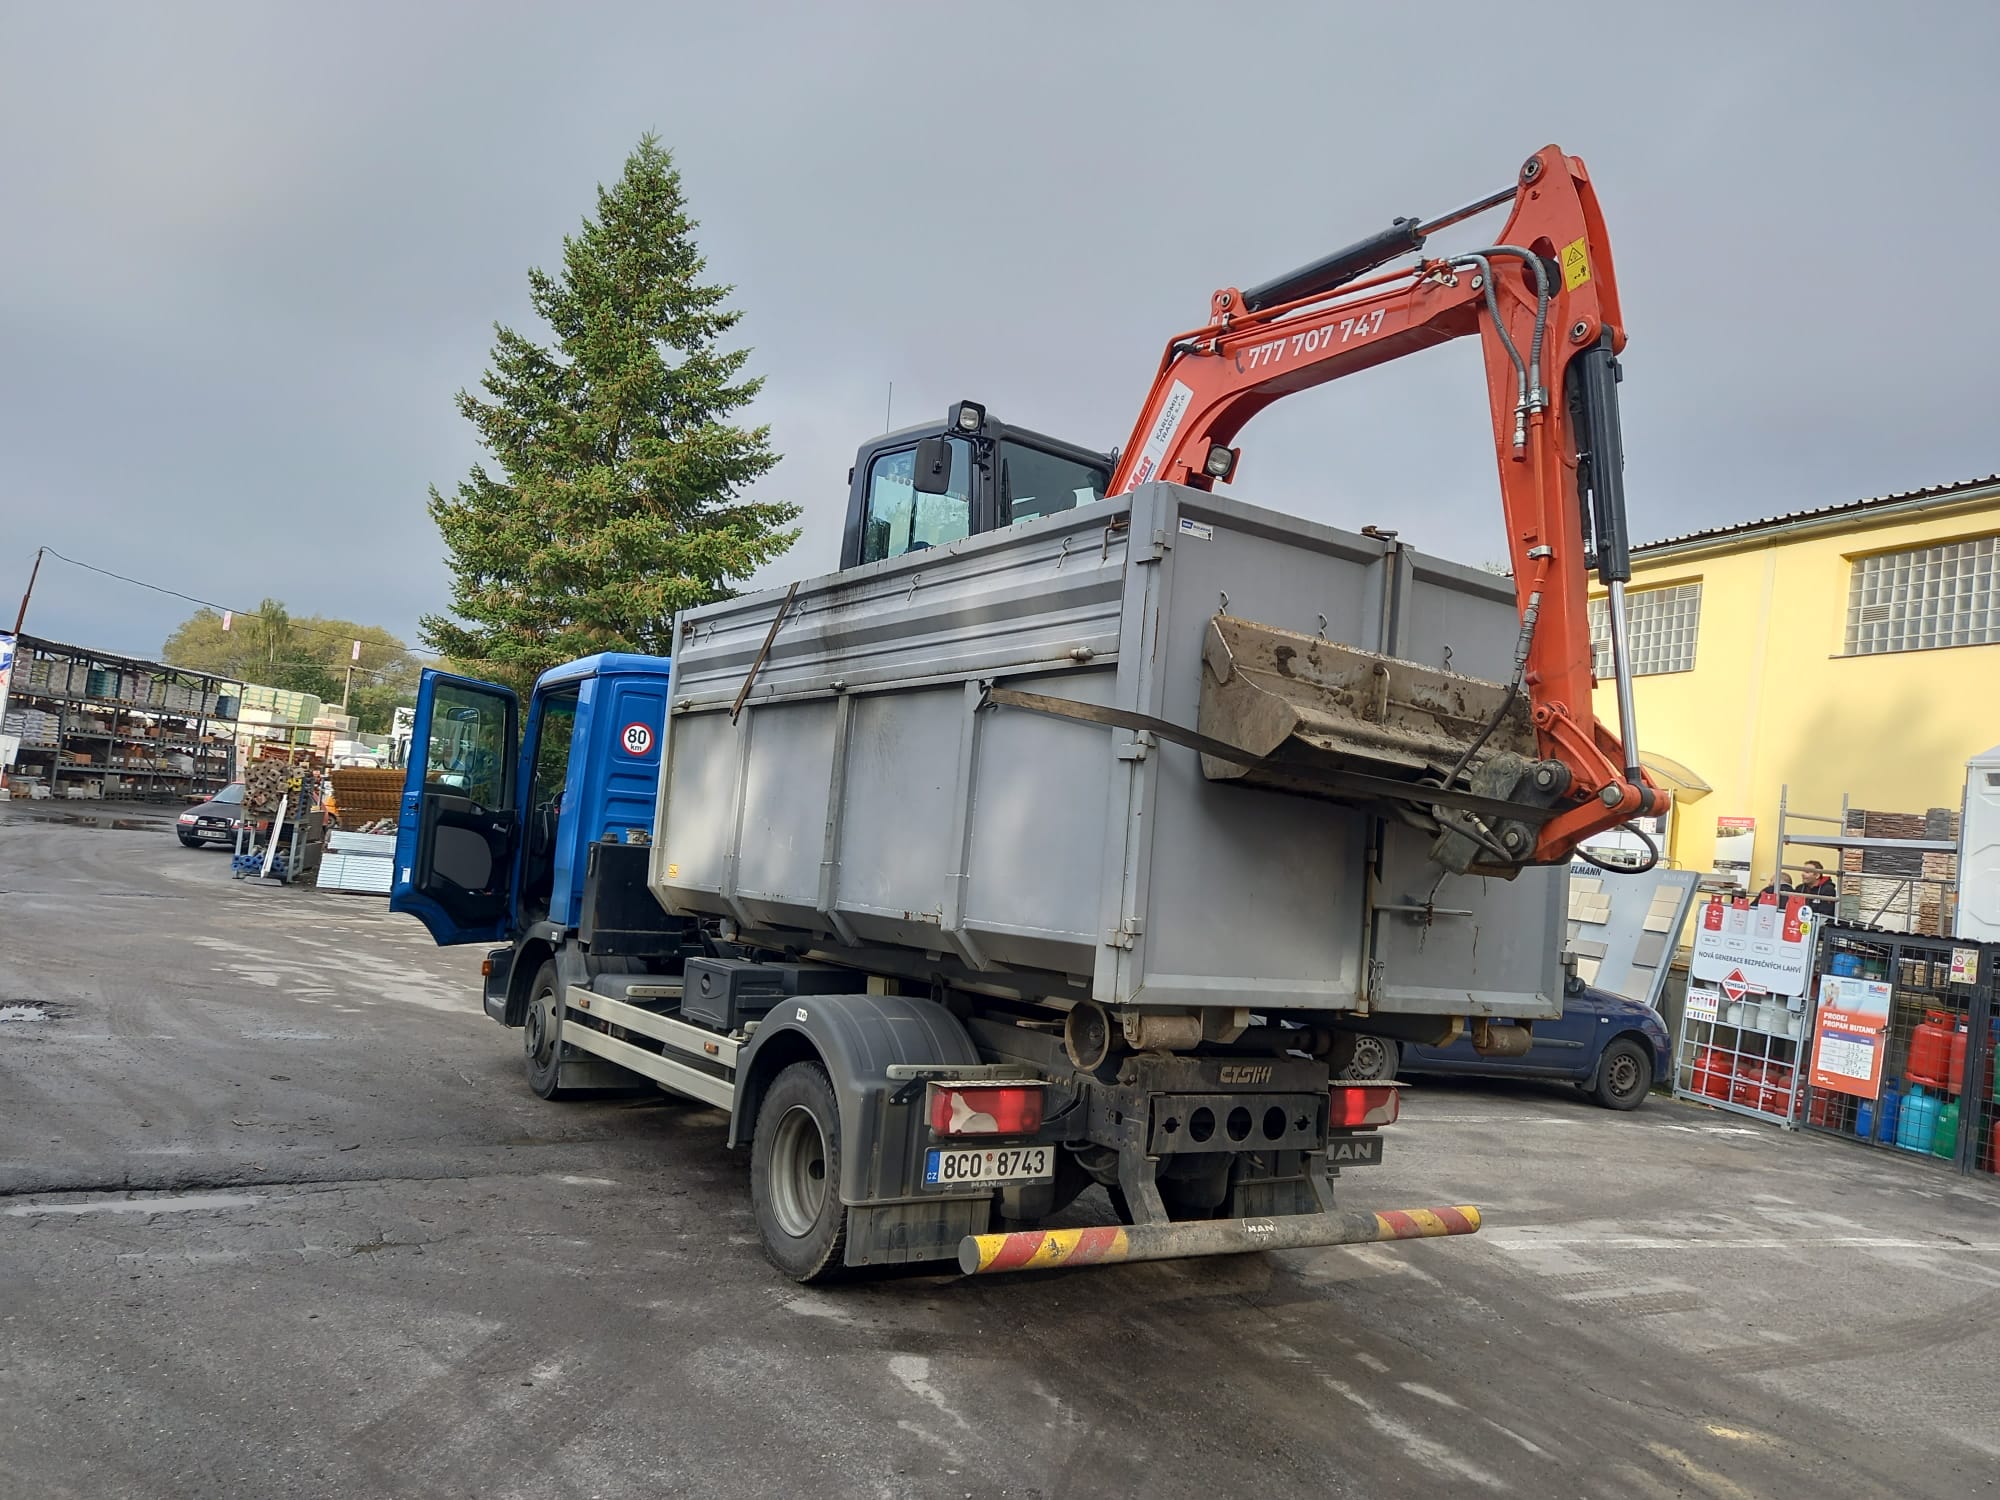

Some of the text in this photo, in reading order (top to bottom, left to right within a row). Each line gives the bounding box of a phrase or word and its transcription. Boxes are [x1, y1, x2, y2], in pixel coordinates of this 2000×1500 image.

[1249, 308, 1386, 369] 777 707 747
[1156, 394, 1180, 440] KARLOMIX
[1160, 415, 1176, 443] TRADE
[627, 728, 647, 745] 80
[630, 743, 642, 751] km
[1570, 865, 1602, 876] ELMANN
[1698, 950, 1803, 974] NOVÁ GENERACE BEZPEČNÝCH LAHVÍ
[1823, 1012, 1848, 1022] PRODEJ
[1822, 1020, 1848, 1030] PROPAN
[1849, 1023, 1877, 1035] BUTANU
[997, 1150, 1045, 1176] 8743
[926, 1172, 937, 1180] CZ
[971, 1180, 996, 1188] MAN
[1247, 1224, 1275, 1233] MAN
